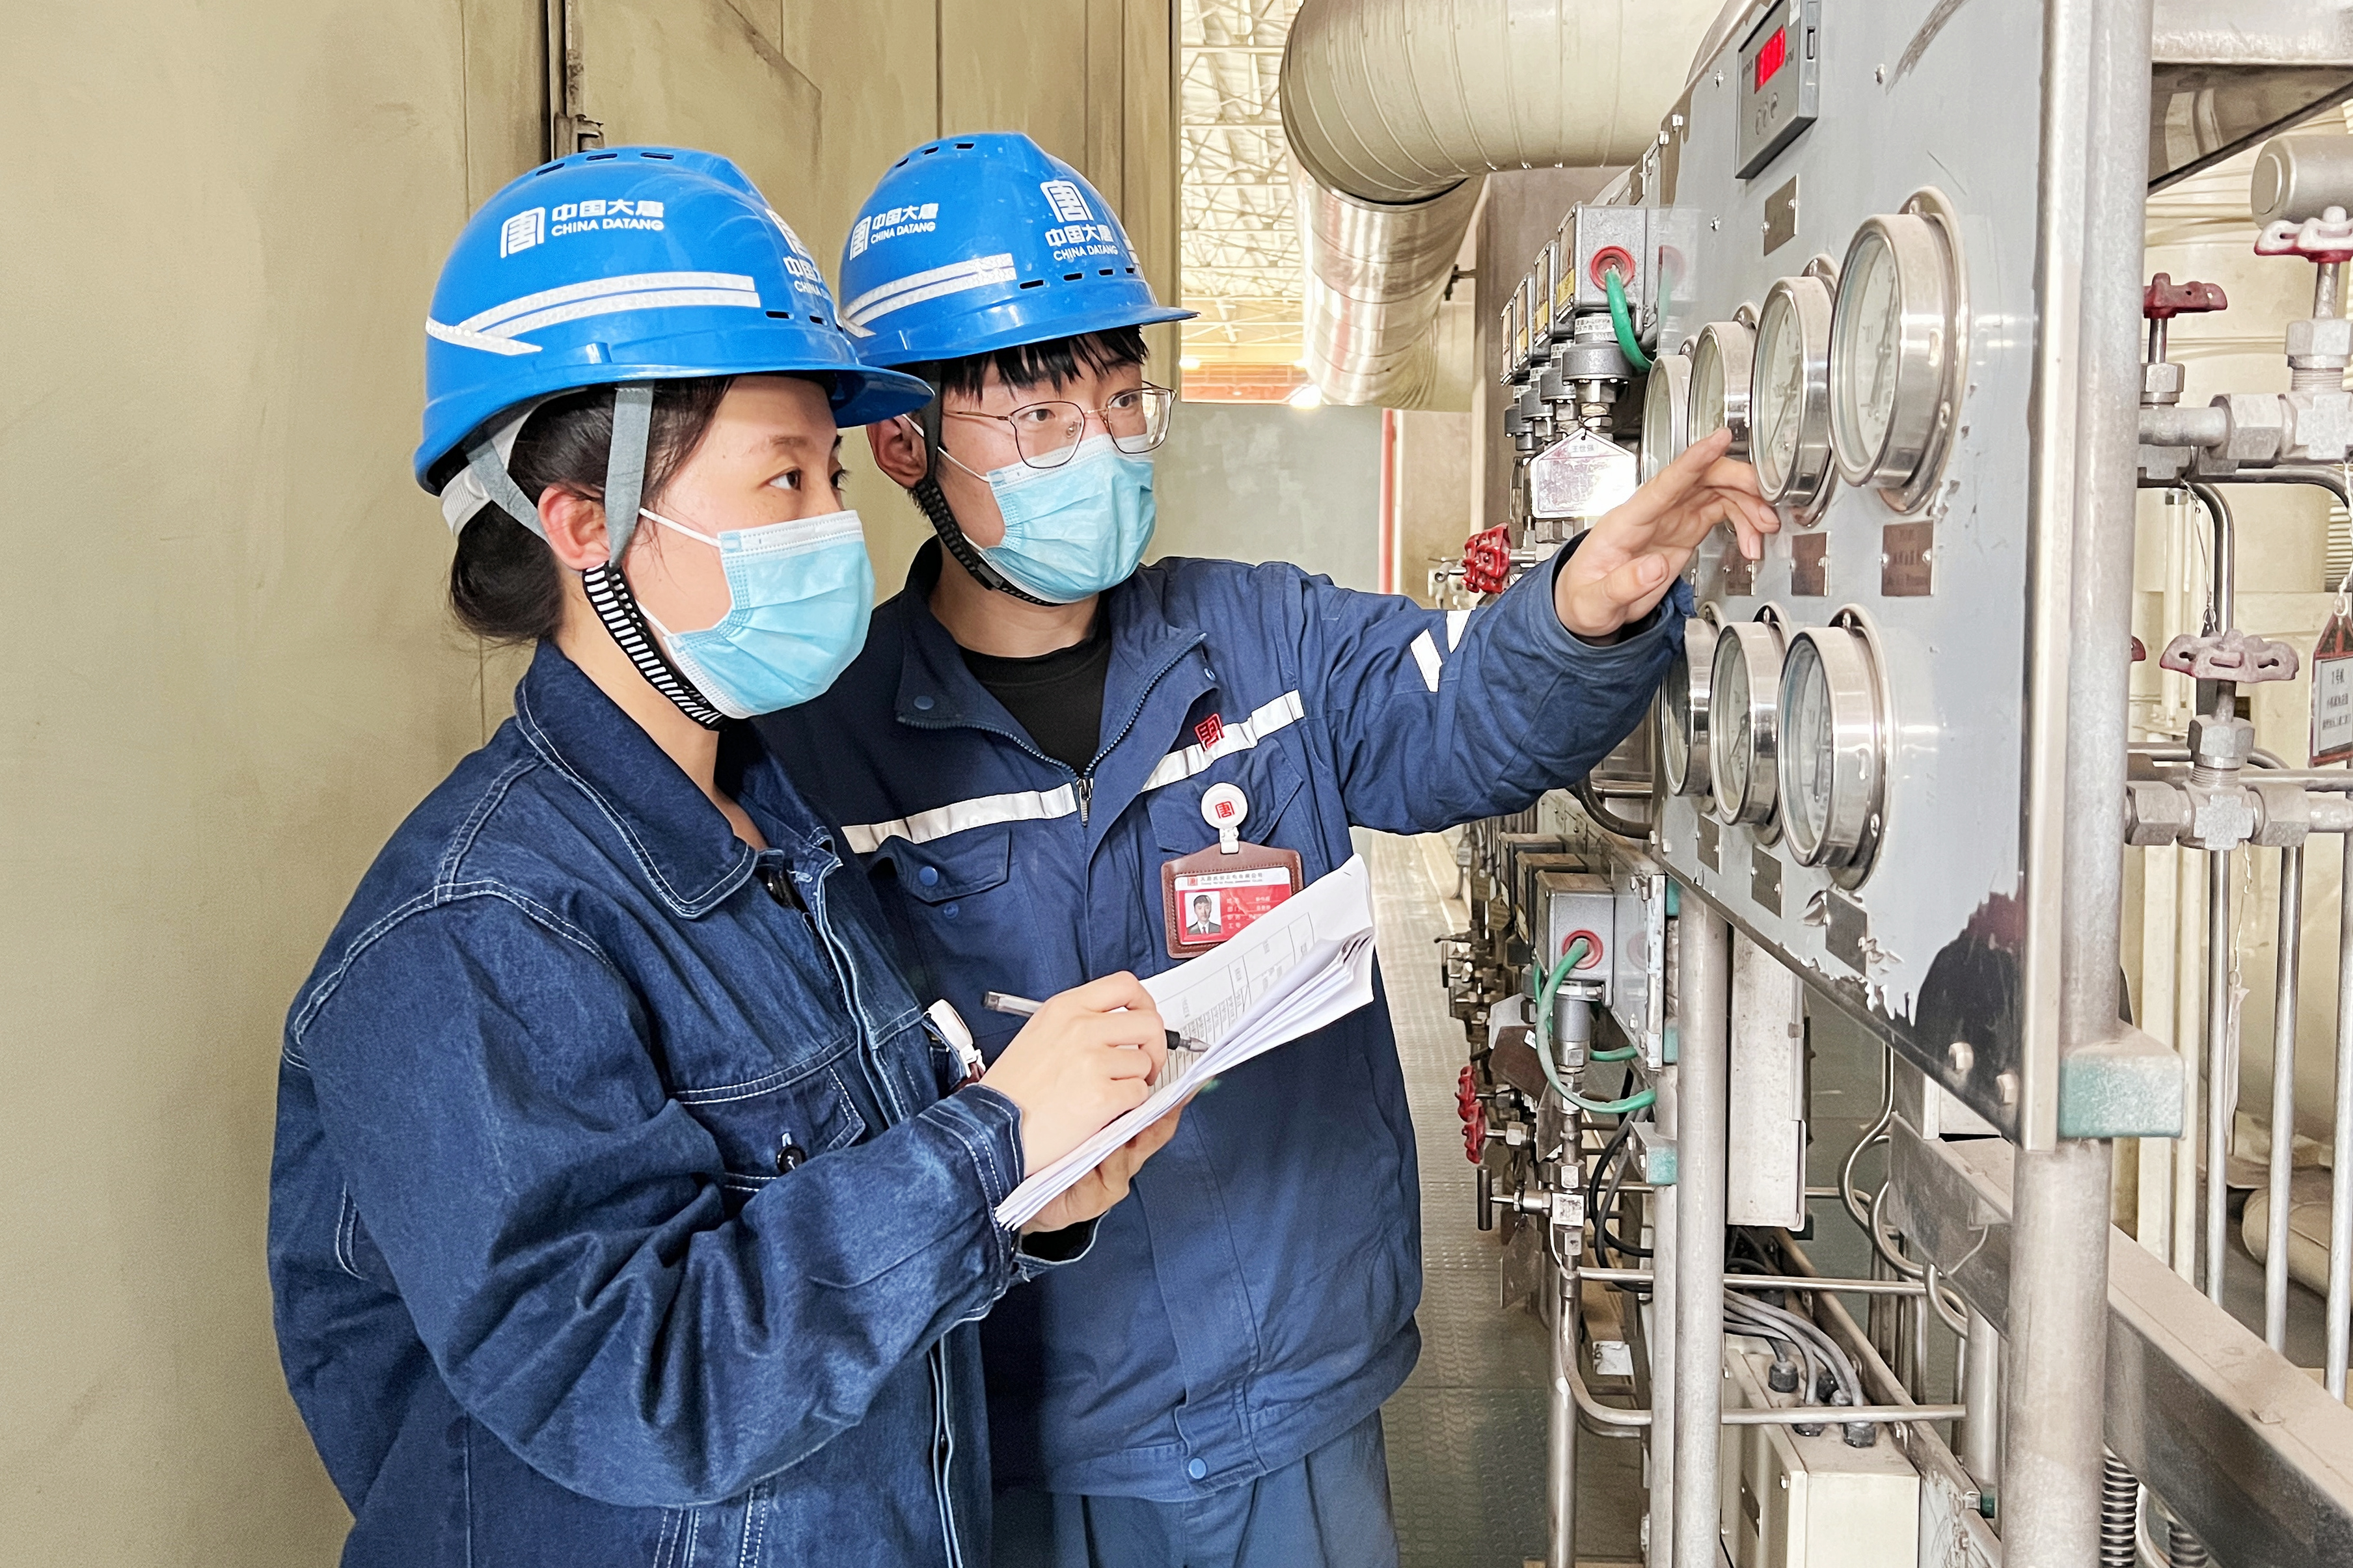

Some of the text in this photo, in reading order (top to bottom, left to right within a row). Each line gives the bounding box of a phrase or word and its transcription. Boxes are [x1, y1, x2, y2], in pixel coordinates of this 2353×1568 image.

[552, 199, 664, 221] 中国大唐
[872, 203, 938, 230] 中国大唐
[551, 218, 664, 236] CHINA DATANG
[871, 221, 936, 244] CHINA DATANG
[1045, 224, 1114, 247] 中国大唐
[1054, 245, 1119, 261] CHINA DATANG
[794, 280, 822, 297] CHINA
